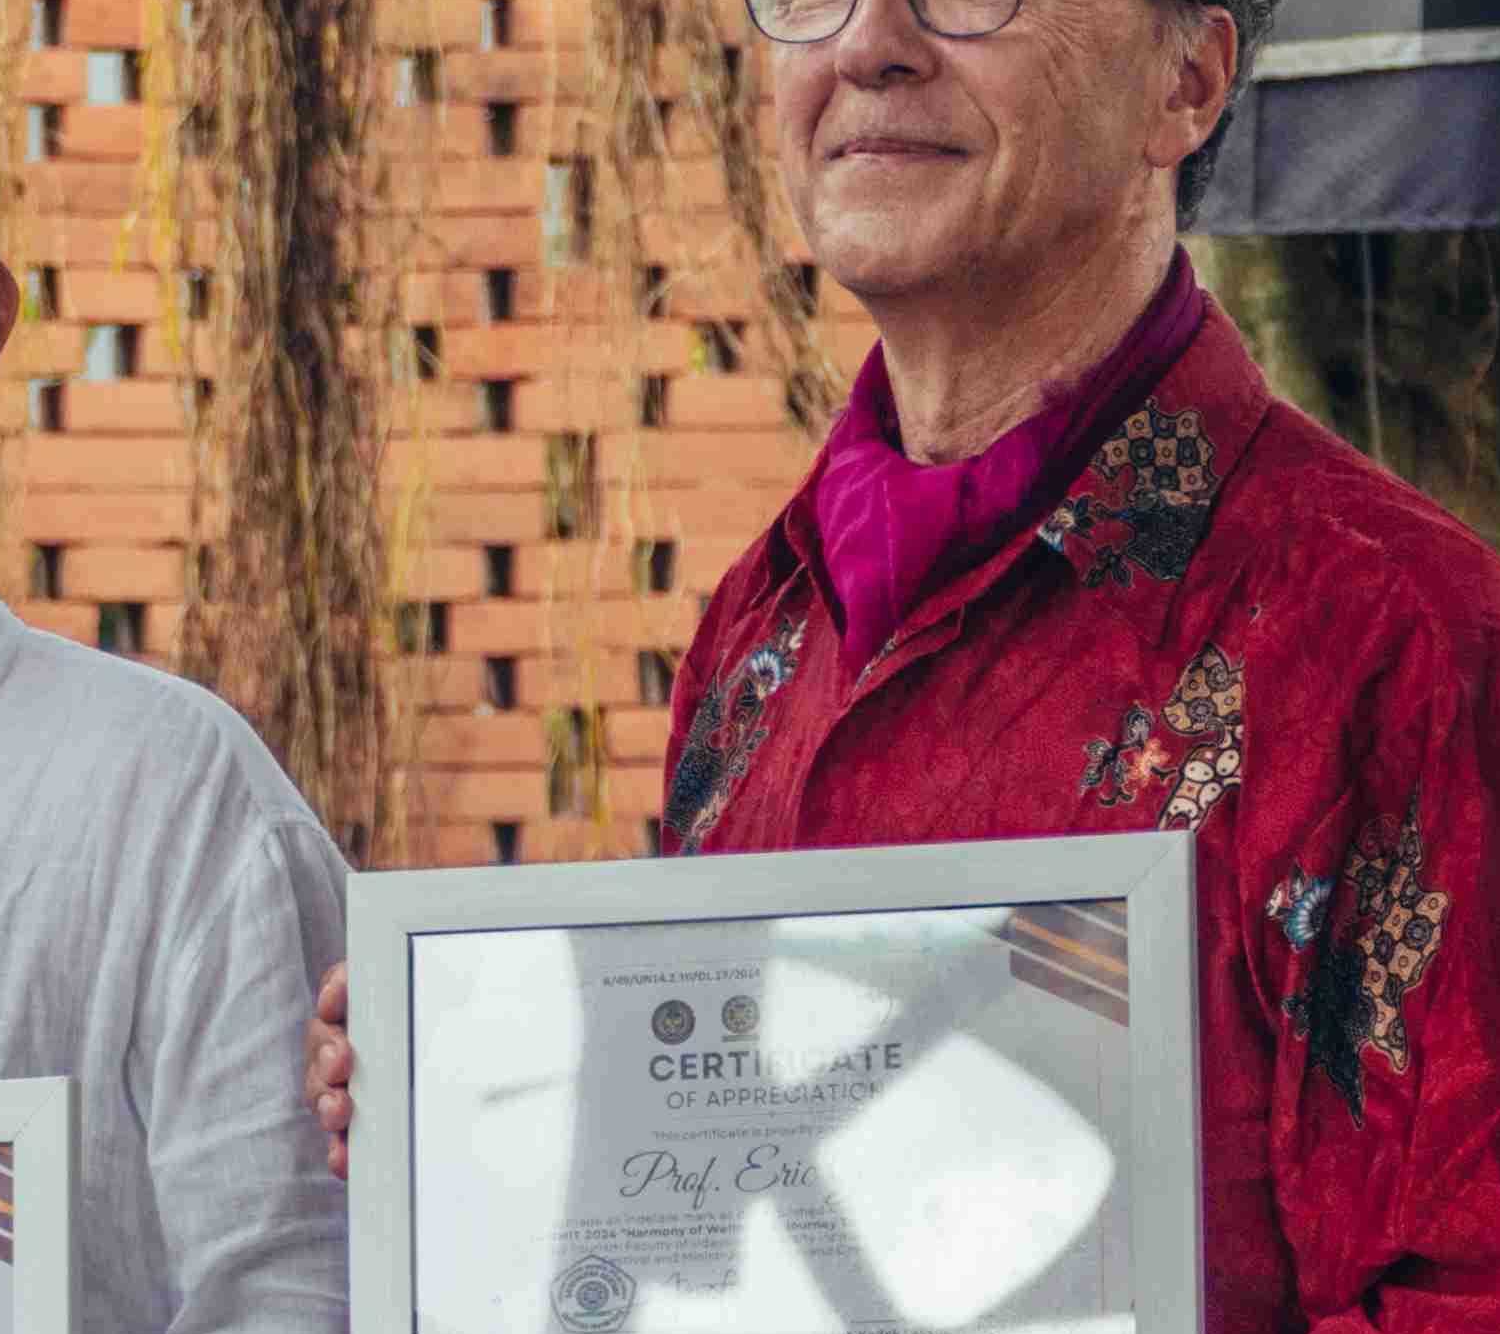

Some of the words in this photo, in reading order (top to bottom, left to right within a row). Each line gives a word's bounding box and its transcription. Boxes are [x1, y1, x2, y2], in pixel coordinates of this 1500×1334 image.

[647, 1042, 903, 1081] CERTIATE
[666, 1090, 697, 1109] OF
[618, 1147, 720, 1213] Prof.
